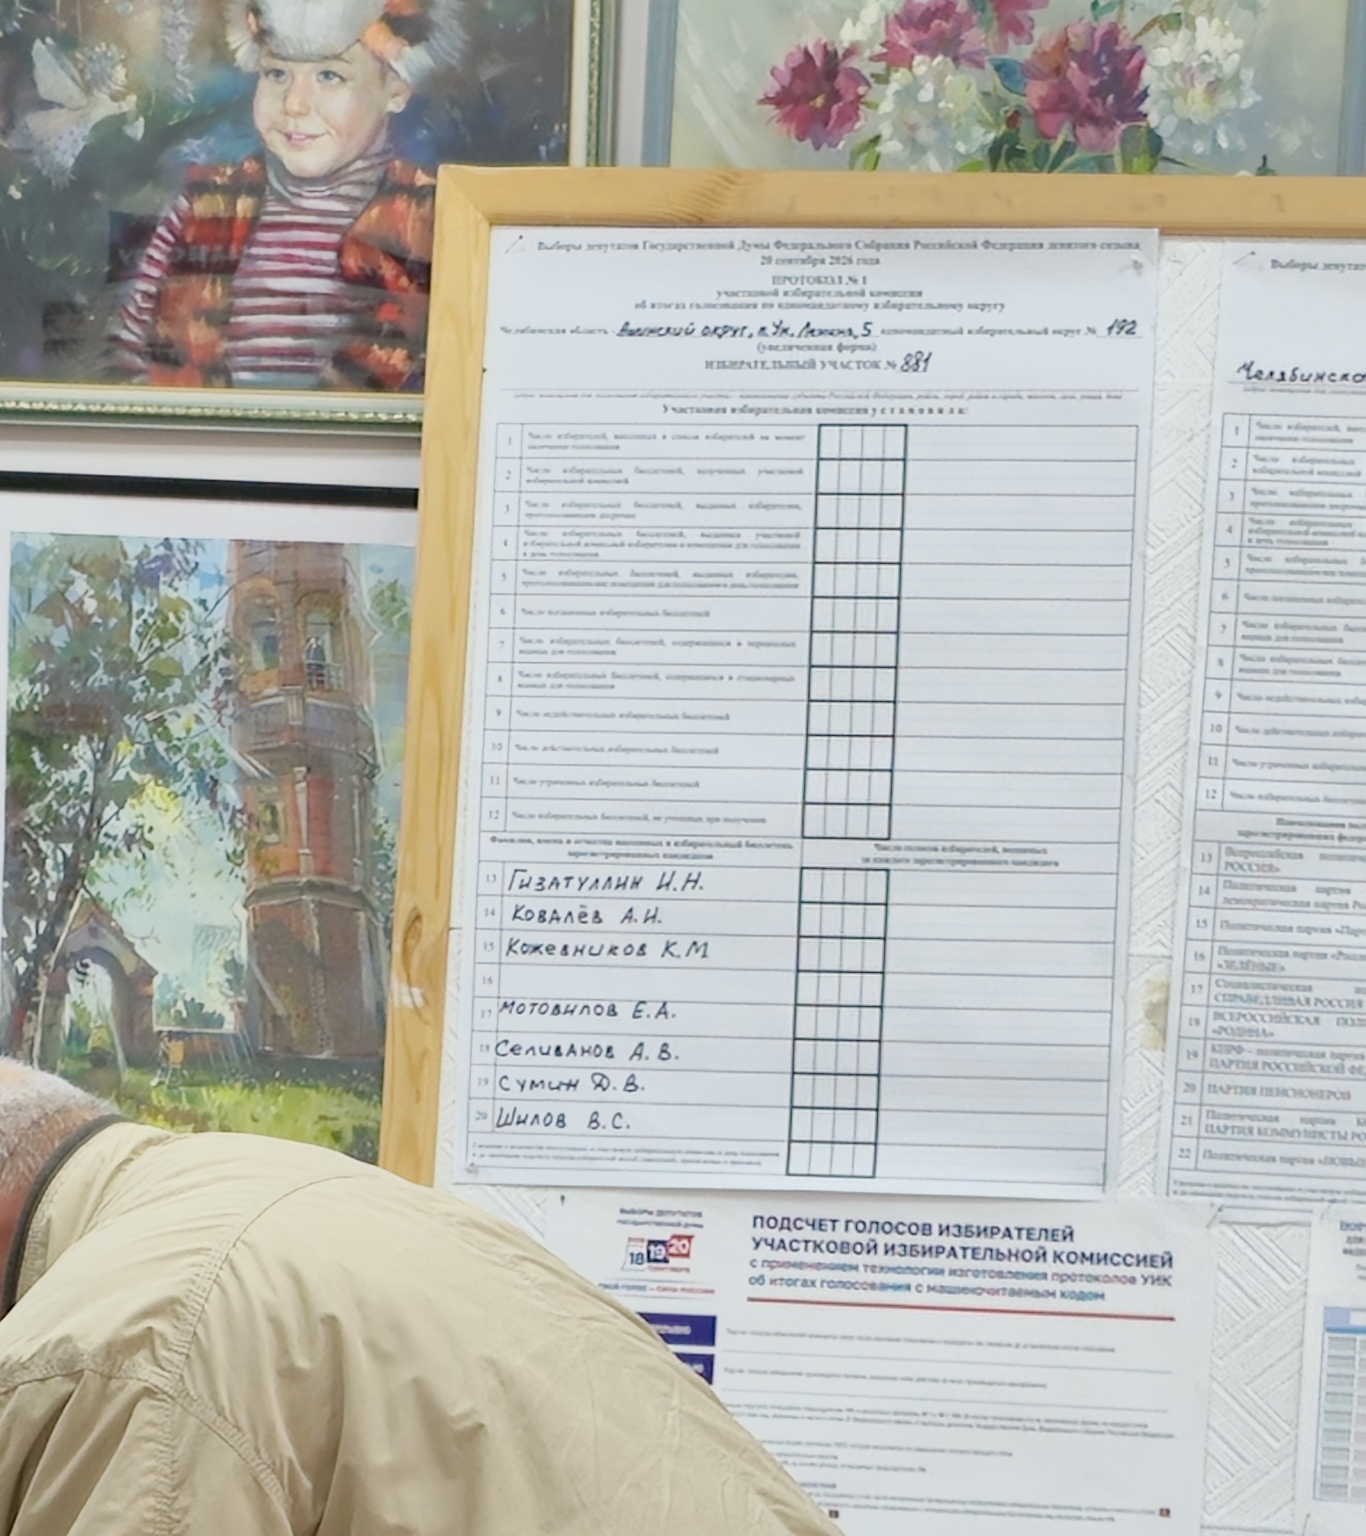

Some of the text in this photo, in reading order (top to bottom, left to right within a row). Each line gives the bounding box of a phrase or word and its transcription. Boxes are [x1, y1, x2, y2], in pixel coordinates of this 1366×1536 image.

[1106, 319, 1137, 335] 192
[900, 351, 933, 372] 881
[511, 904, 604, 925] Ковалёв
[504, 937, 648, 958] Кожевников
[494, 1039, 615, 1060] Селиванов
[498, 1075, 580, 1092] Сумин
[495, 1107, 567, 1129] Шилов
[752, 1215, 1075, 1247] ПОДСЧЕТ ГОЛОСОВ ИЗБИРАТЕЛЕЙ
[629, 1239, 690, 1265] 18 19 20
[751, 1237, 1174, 1269] УЧАСТКОВОЙ ИЗБИРАТЕЛЬНОЙ КОМИССИЕЙ
[761, 1261, 859, 1277] применением
[862, 1265, 946, 1278] технологии
[950, 1268, 1048, 1282] изготовления
[1051, 1272, 1137, 1287] протоколов
[1140, 1274, 1173, 1287] УИК
[748, 1274, 765, 1286] об
[769, 1278, 817, 1290] итогах
[820, 1281, 911, 1293] голосования
[927, 1285, 1056, 1300] машиночитаемым
[1060, 1288, 1105, 1301] кодом
